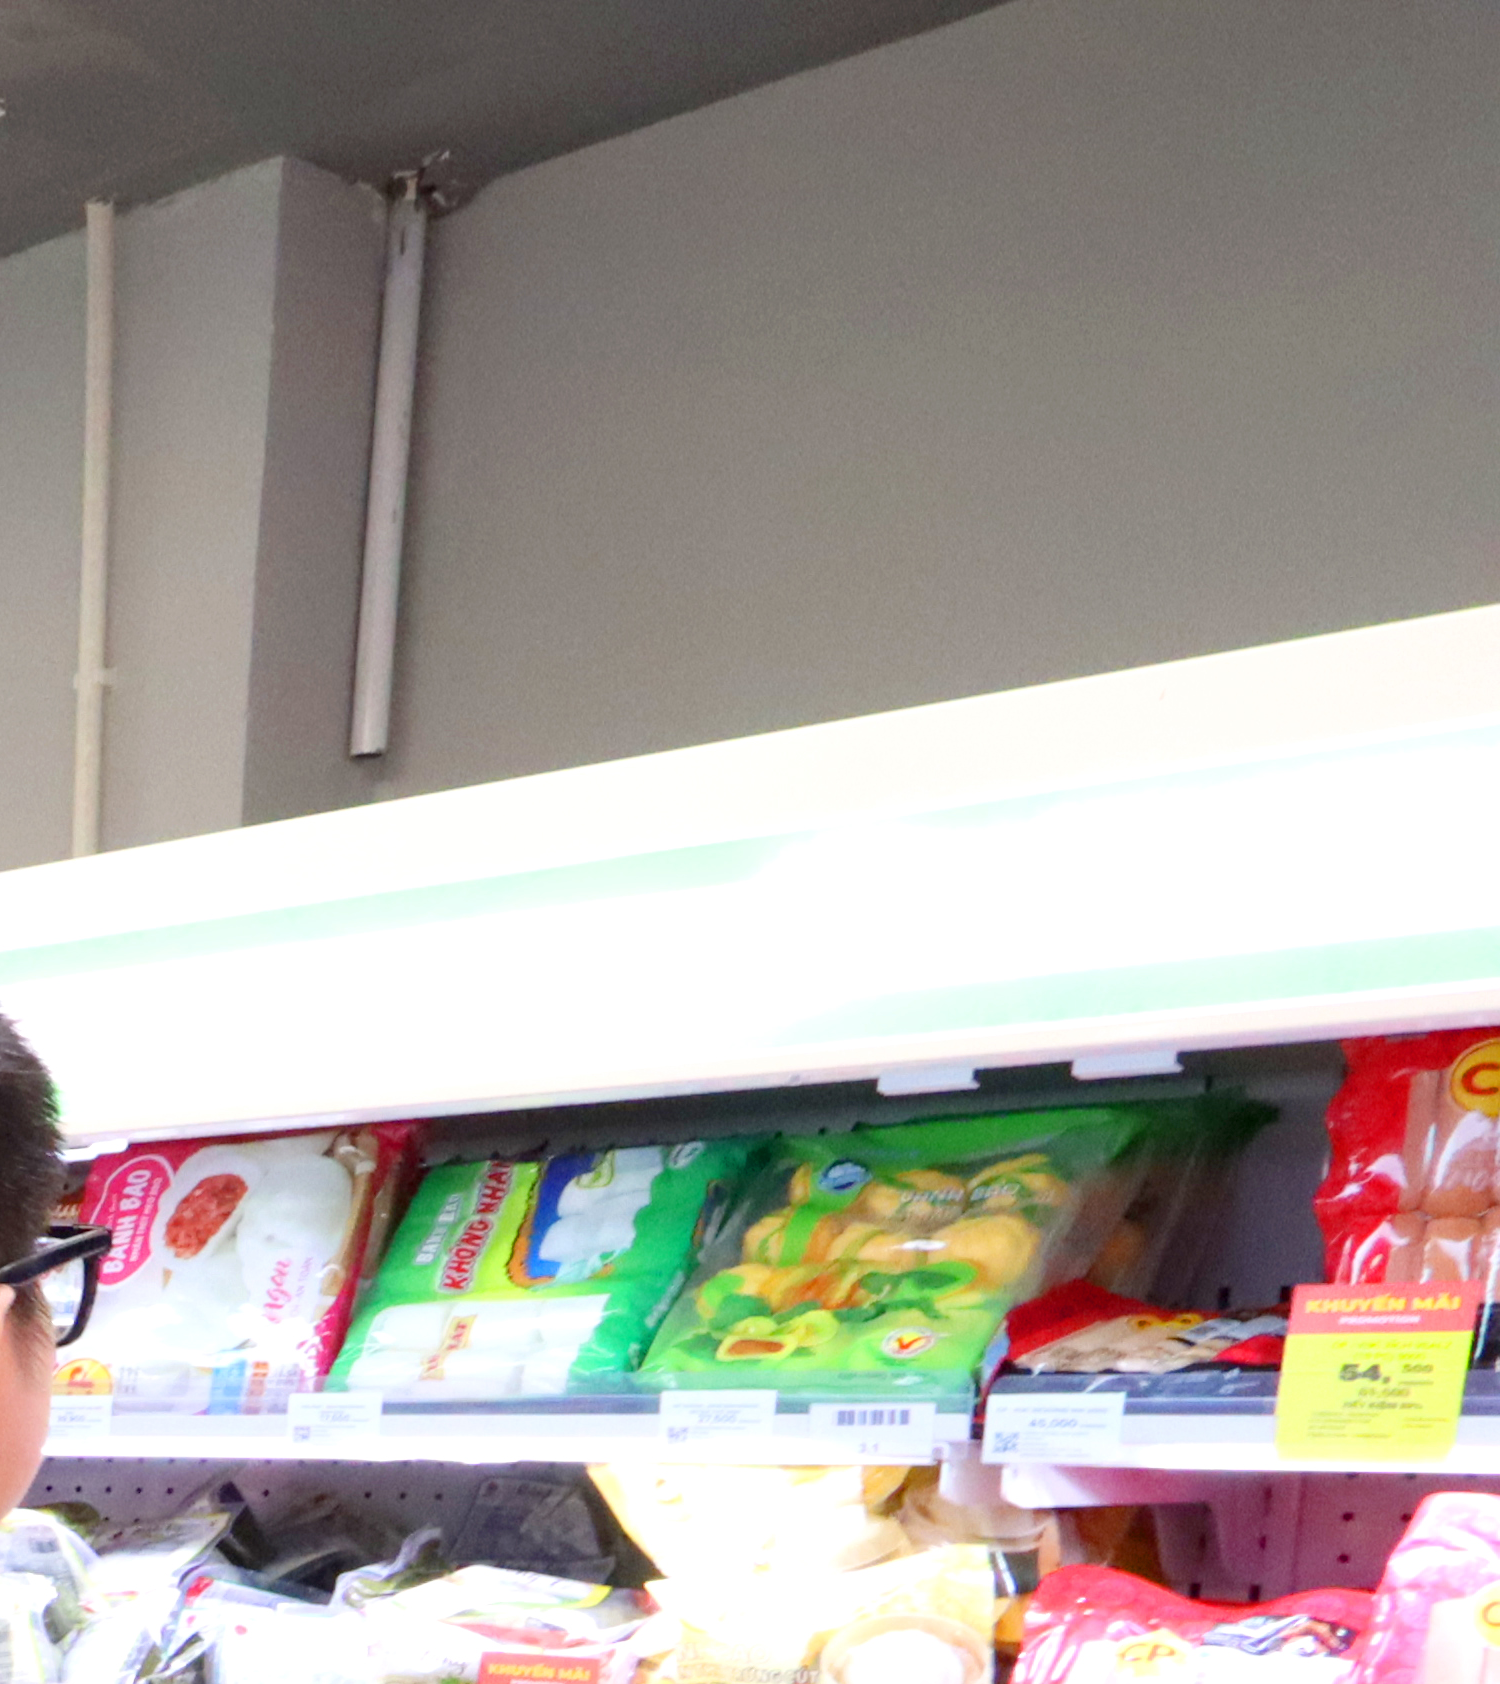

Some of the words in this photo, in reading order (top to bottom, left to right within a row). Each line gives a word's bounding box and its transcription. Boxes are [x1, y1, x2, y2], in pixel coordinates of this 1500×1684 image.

[1461, 1062, 1500, 1096] C
[119, 1169, 152, 1212] BAO
[442, 1219, 490, 1290] KHÔNG
[1305, 1293, 1407, 1314] KHUYẾN
[1411, 1292, 1462, 1311] MÃI
[488, 1663, 557, 1679] KHUYẾN
[557, 1667, 591, 1681] MÃI
